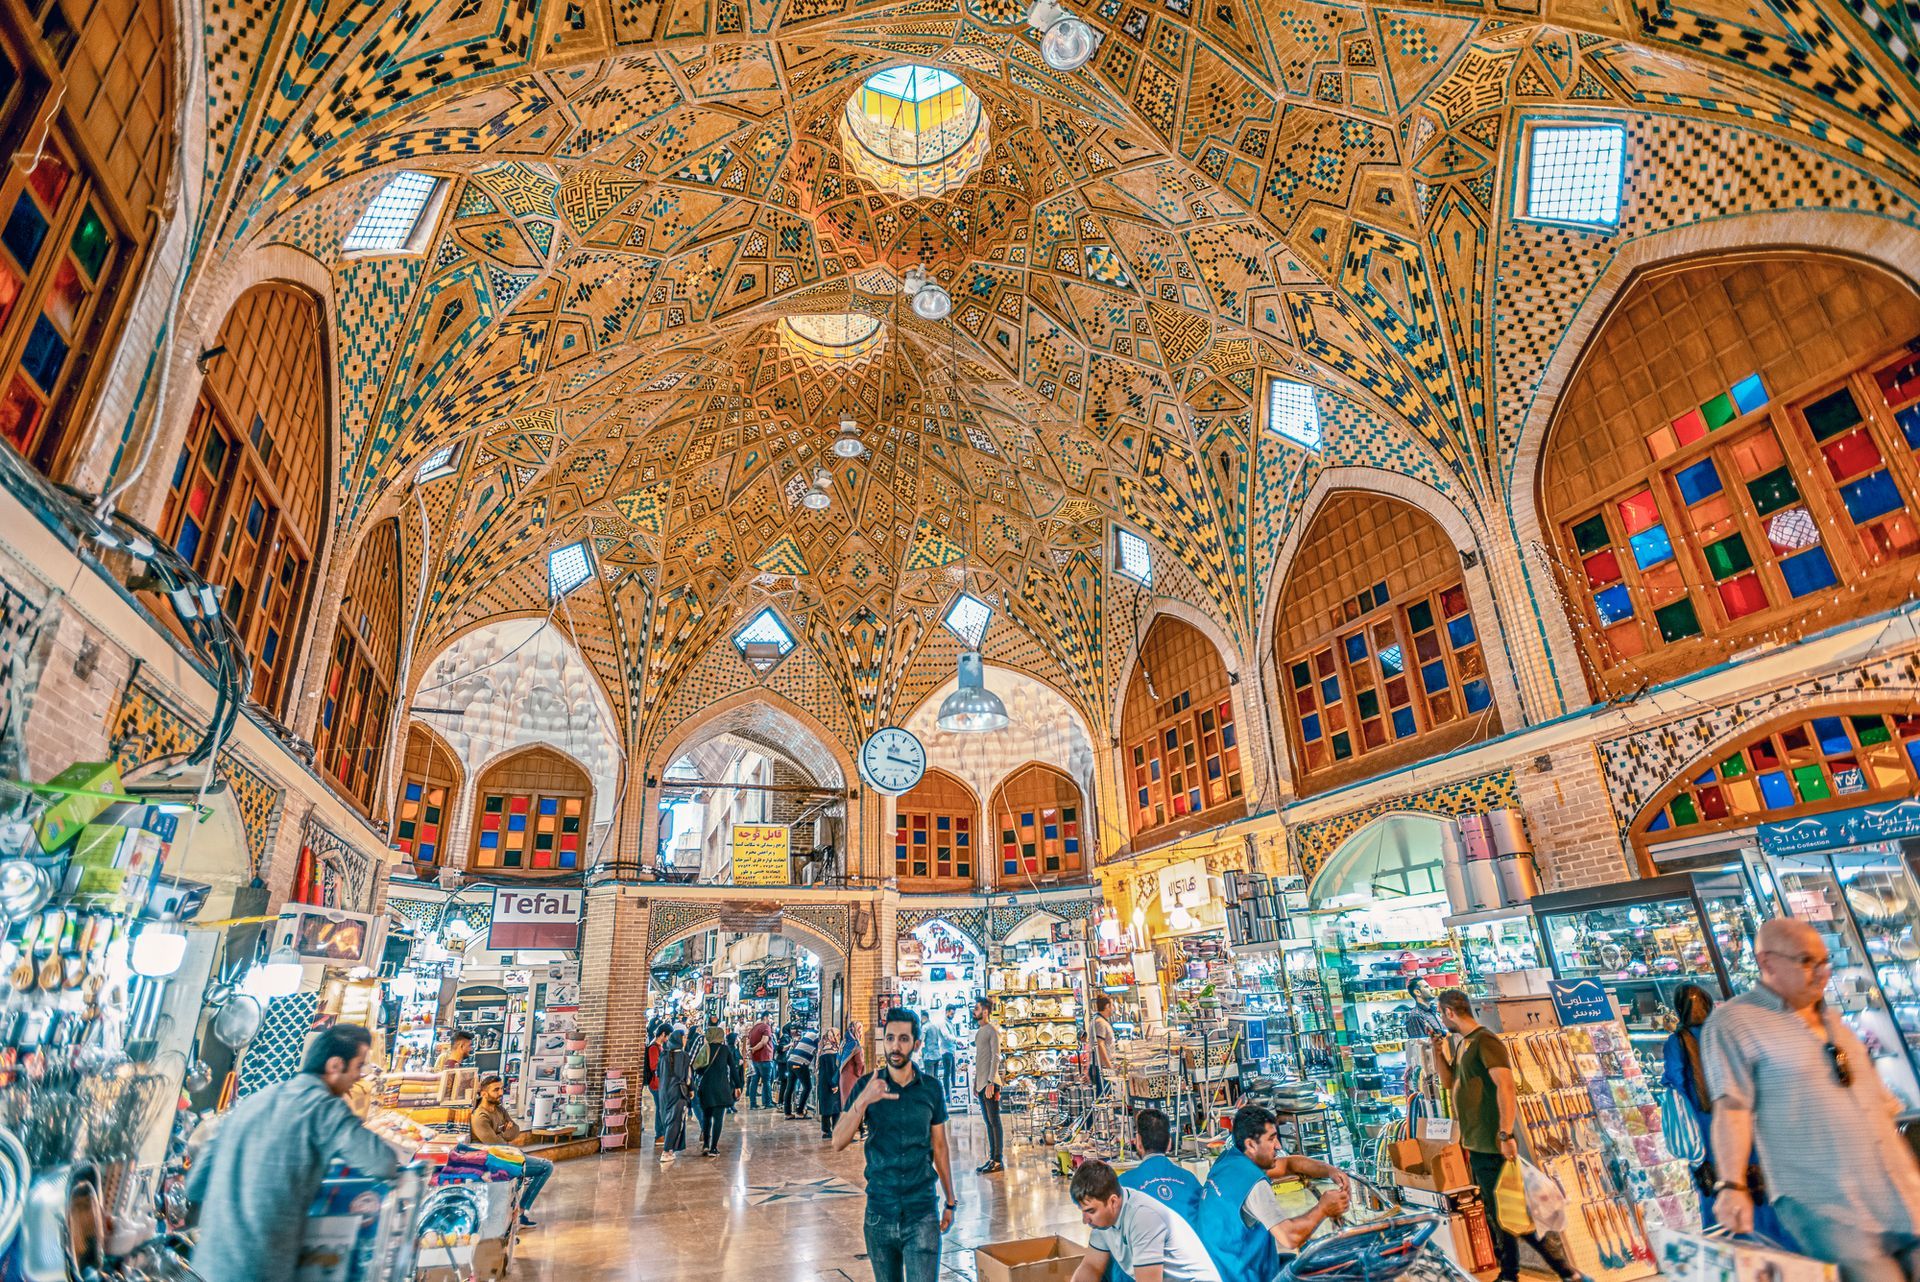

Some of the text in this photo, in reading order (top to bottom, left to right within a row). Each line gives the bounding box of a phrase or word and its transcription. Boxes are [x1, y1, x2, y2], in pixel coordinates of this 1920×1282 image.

[738, 828, 782, 841] قابل توجه
[1777, 839, 1831, 852] Home Collection
[500, 893, 576, 915] TefaL
[1557, 991, 1604, 1009] سیلویا
